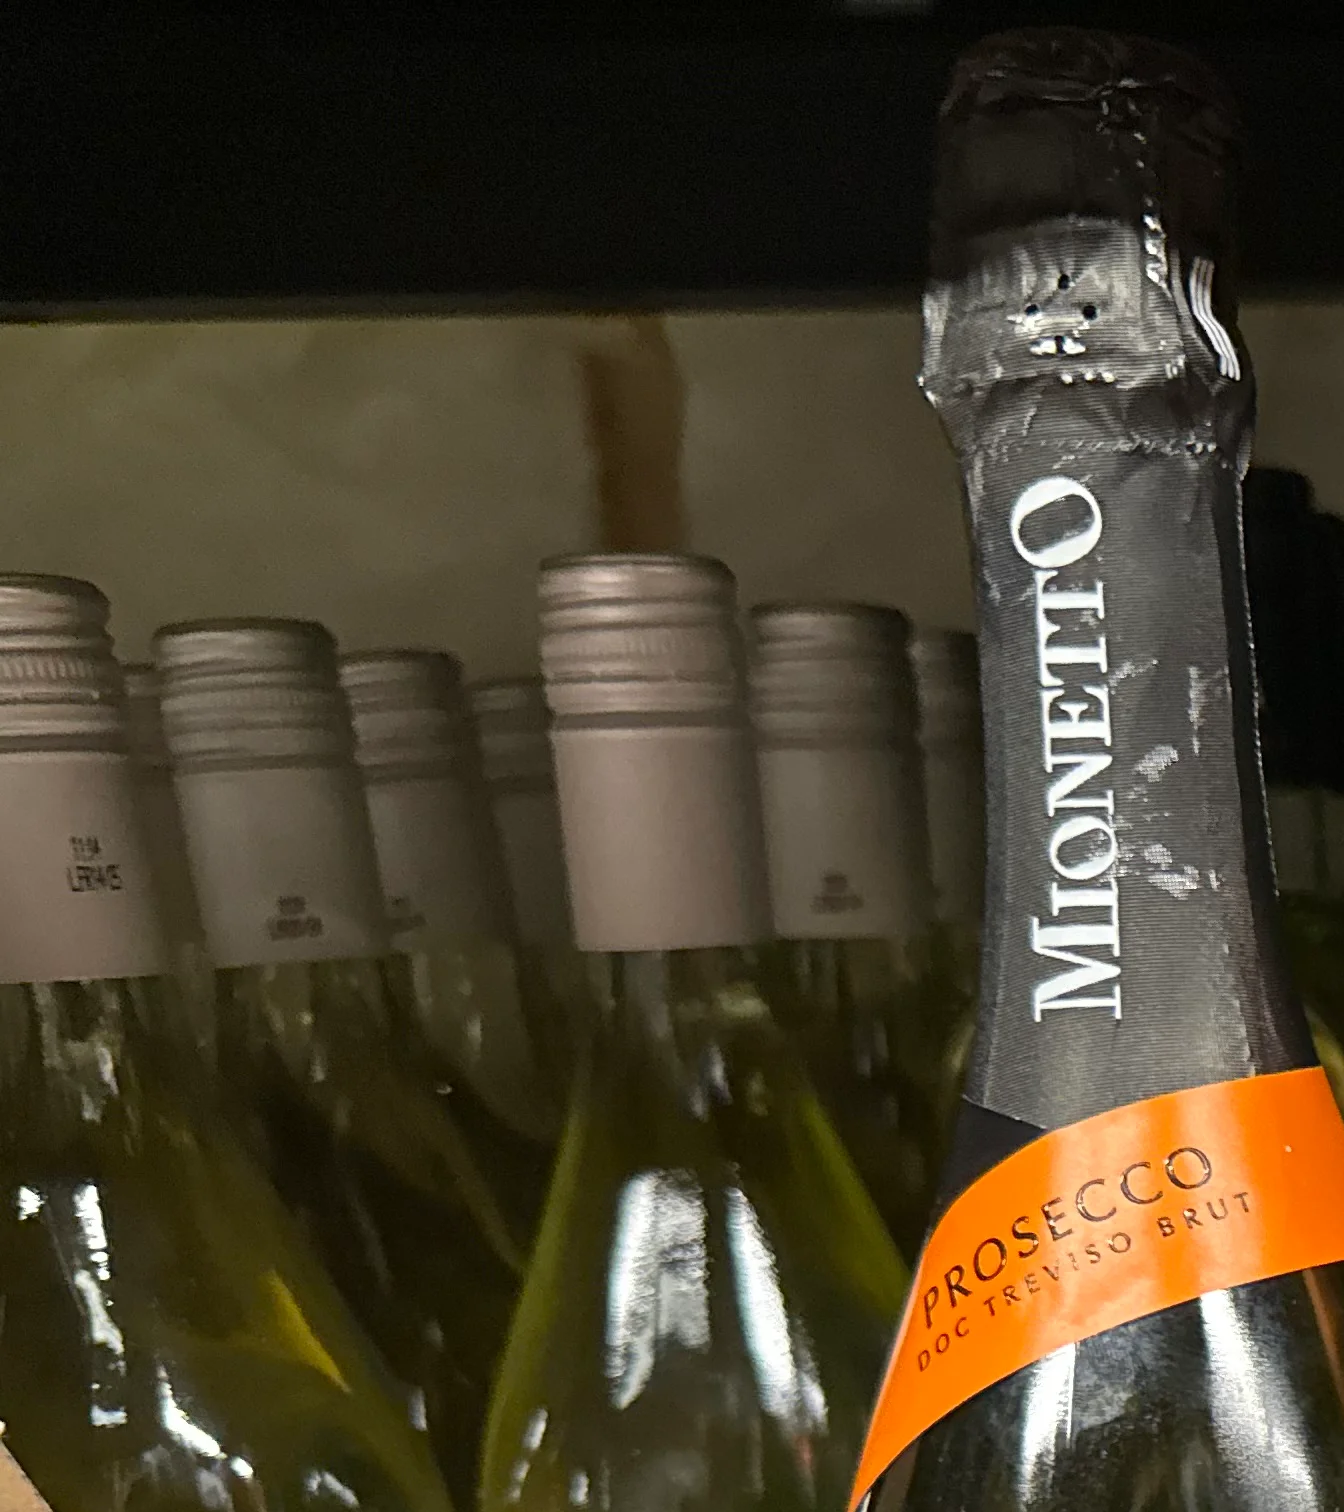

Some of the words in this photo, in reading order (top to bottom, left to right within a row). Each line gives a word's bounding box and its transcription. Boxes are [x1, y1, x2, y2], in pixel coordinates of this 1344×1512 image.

[1010, 475, 1121, 1022] MIONETTO
[918, 1318, 970, 1373] DOC
[983, 1231, 1131, 1316] TREVISO
[1157, 1191, 1253, 1237] BRUT
[923, 1146, 1213, 1329] PROSECCO
